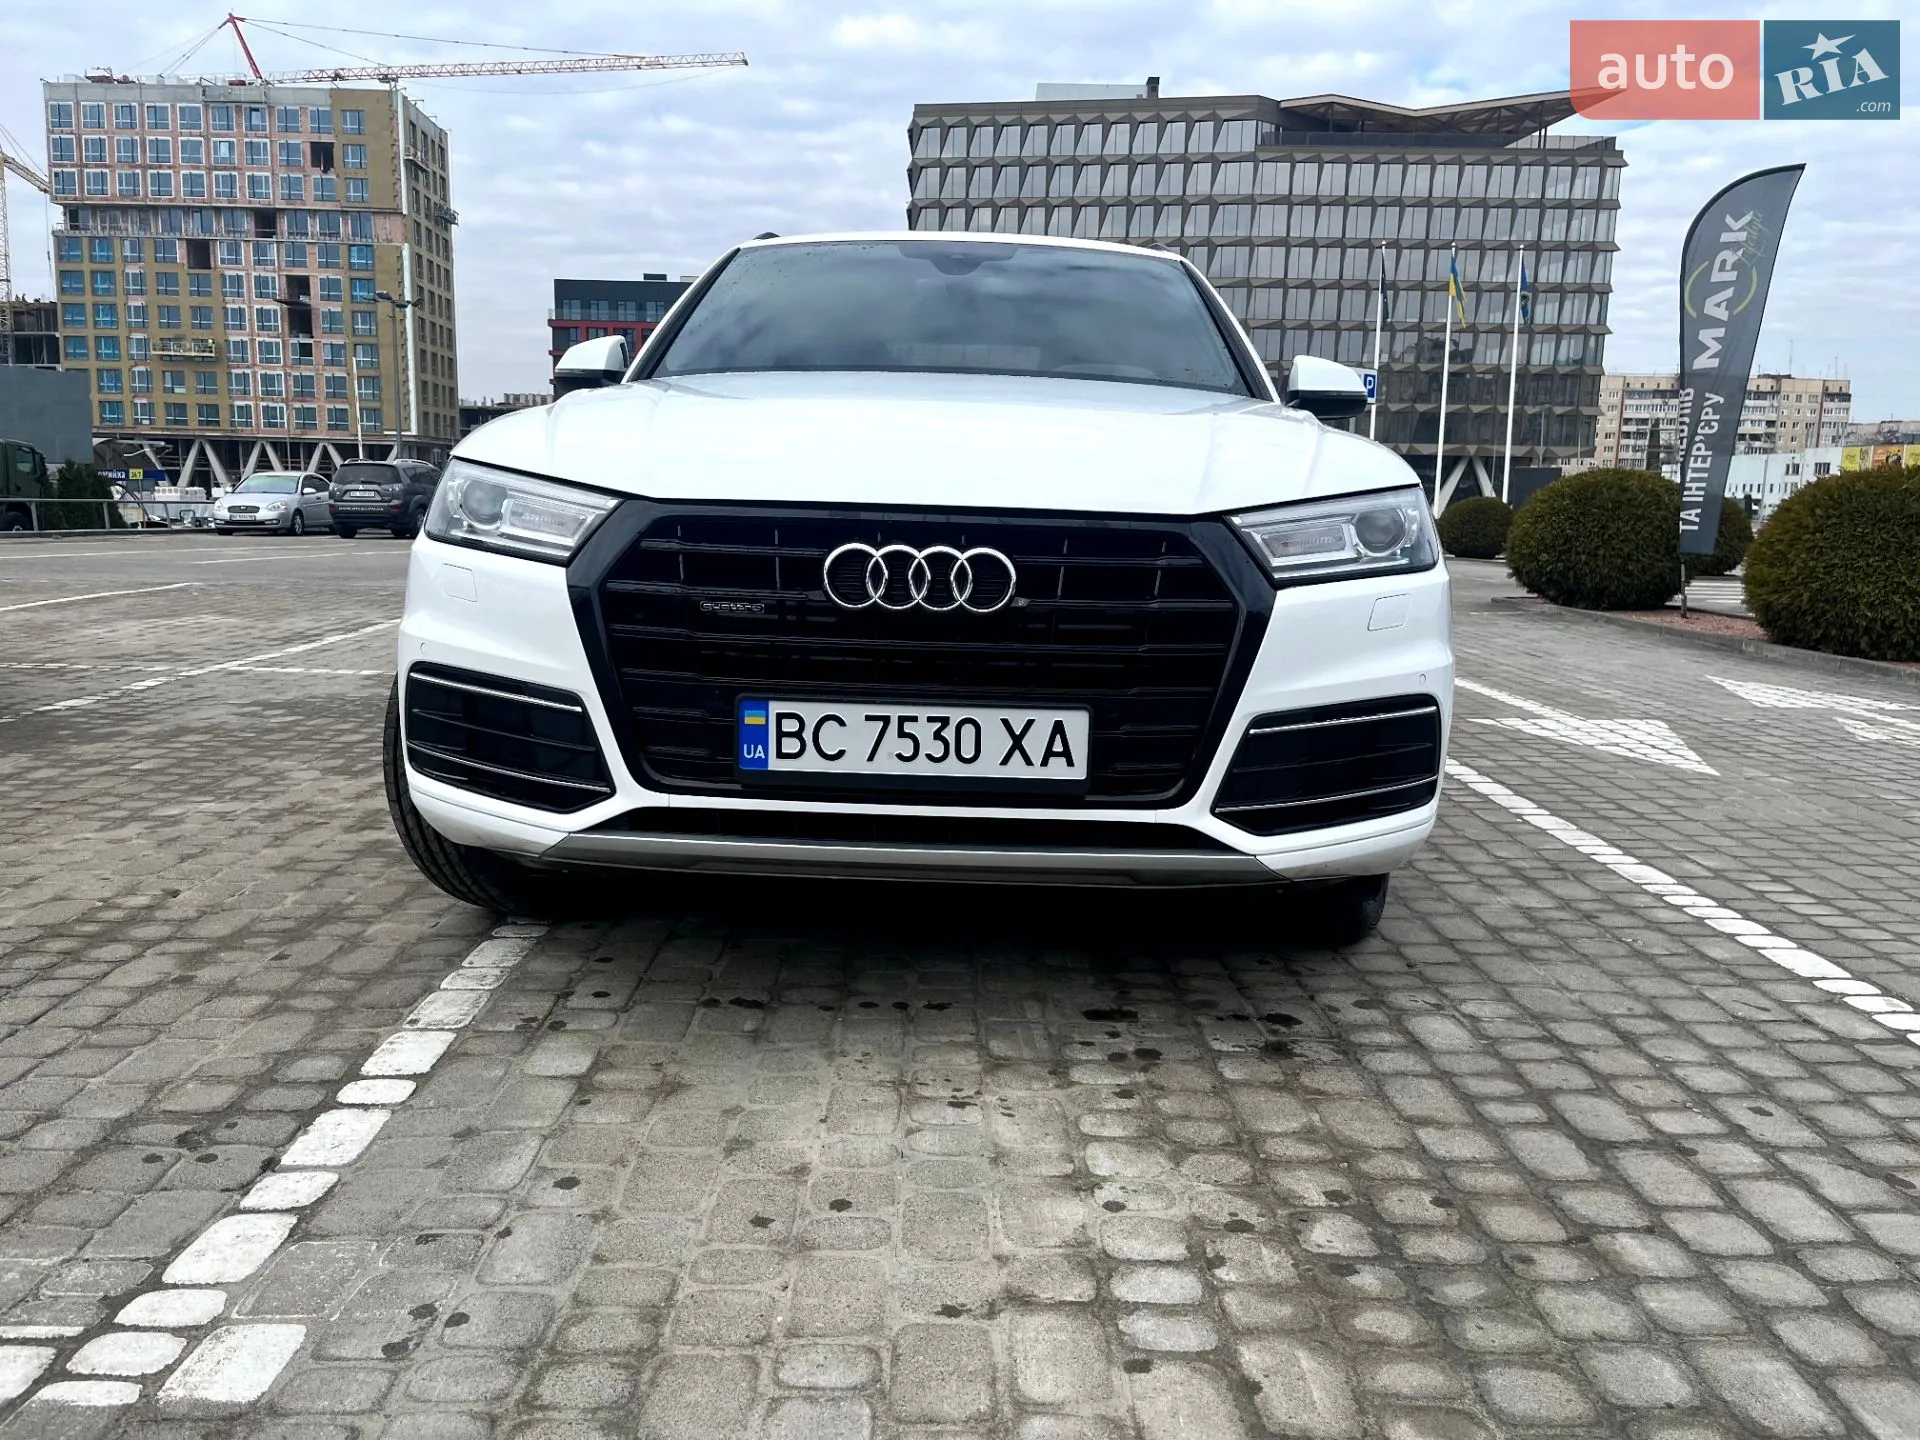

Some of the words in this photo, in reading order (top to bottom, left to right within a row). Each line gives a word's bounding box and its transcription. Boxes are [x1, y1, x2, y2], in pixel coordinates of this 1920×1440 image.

[1692, 210, 1754, 370] MARK
[1366, 376, 1374, 390] P
[1679, 508, 1702, 534] ТА
[743, 744, 766, 759] UA
[775, 711, 847, 762] BC
[864, 714, 982, 764] 7530
[999, 717, 1076, 768] XA
